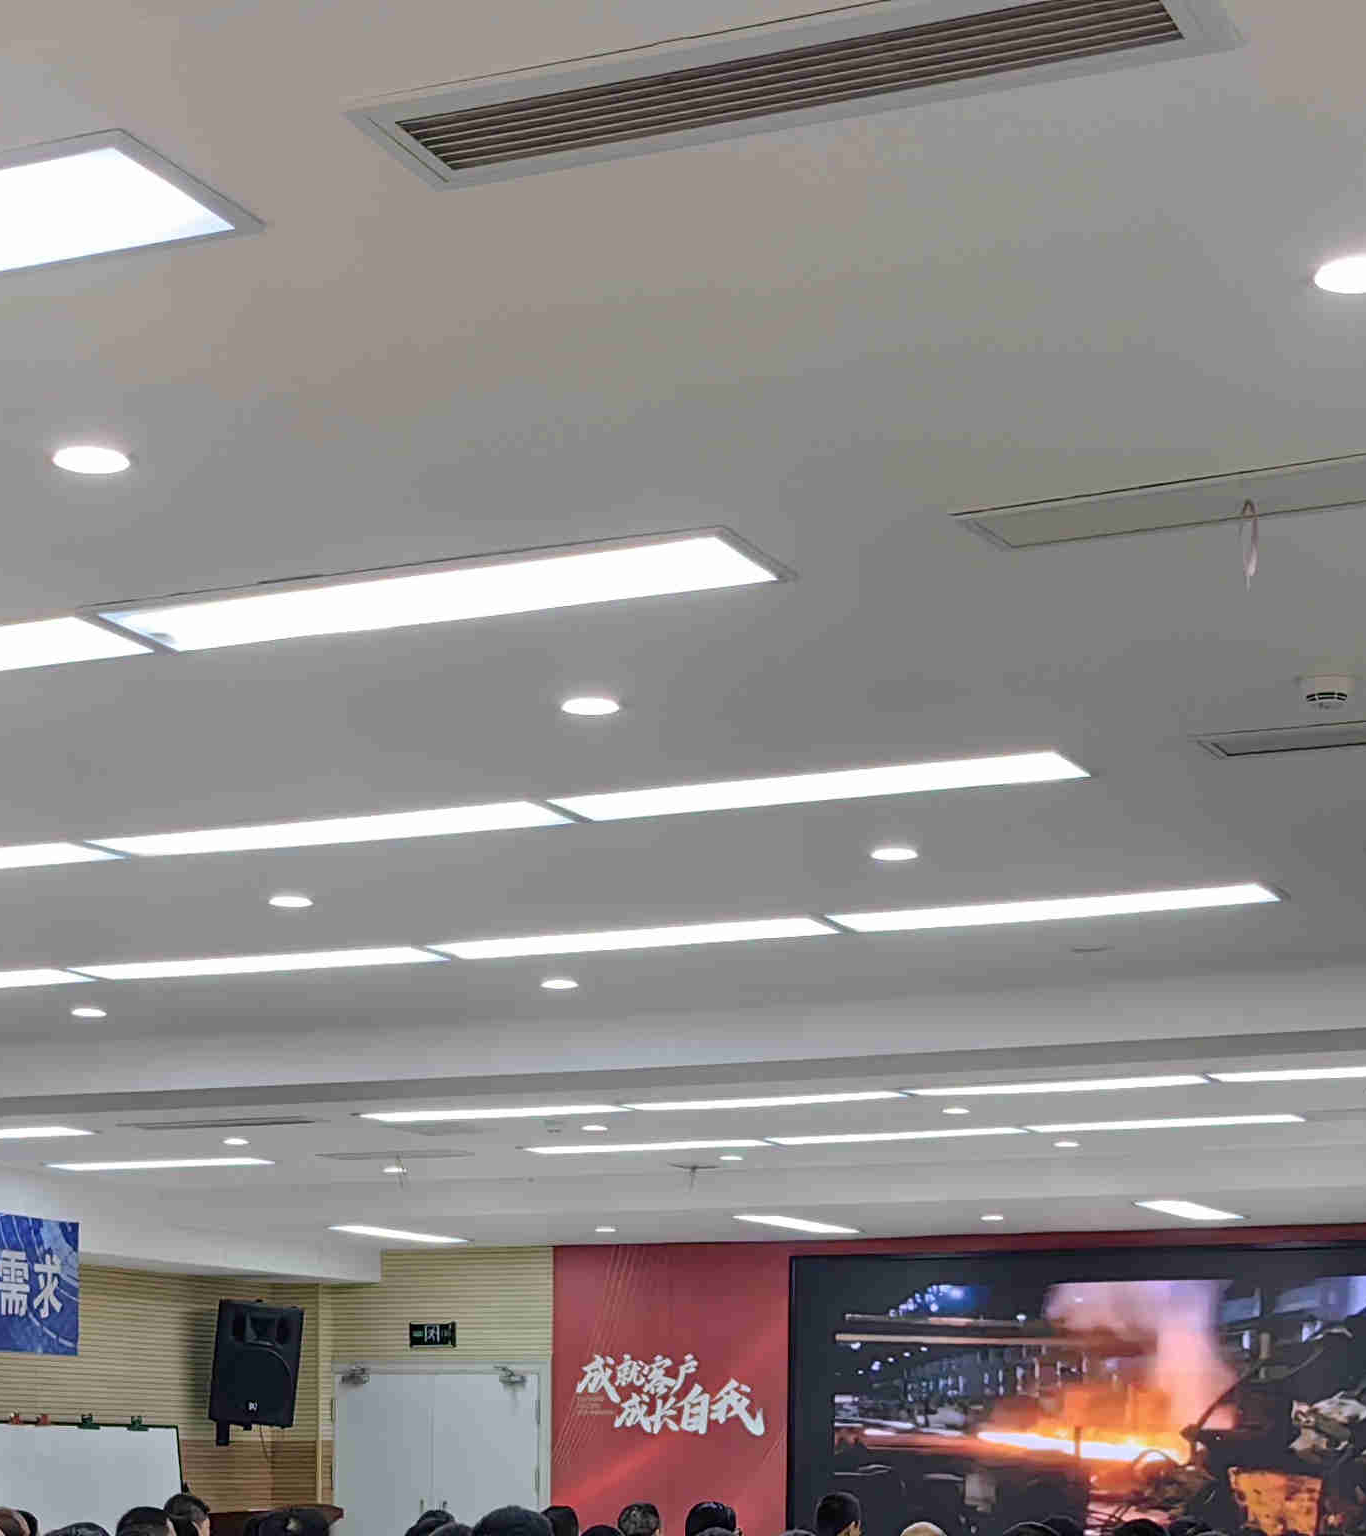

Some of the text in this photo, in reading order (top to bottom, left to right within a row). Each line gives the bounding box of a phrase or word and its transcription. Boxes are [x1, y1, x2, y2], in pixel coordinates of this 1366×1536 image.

[576, 1353, 698, 1404] 成就客户
[614, 1377, 765, 1436] 成长自我
